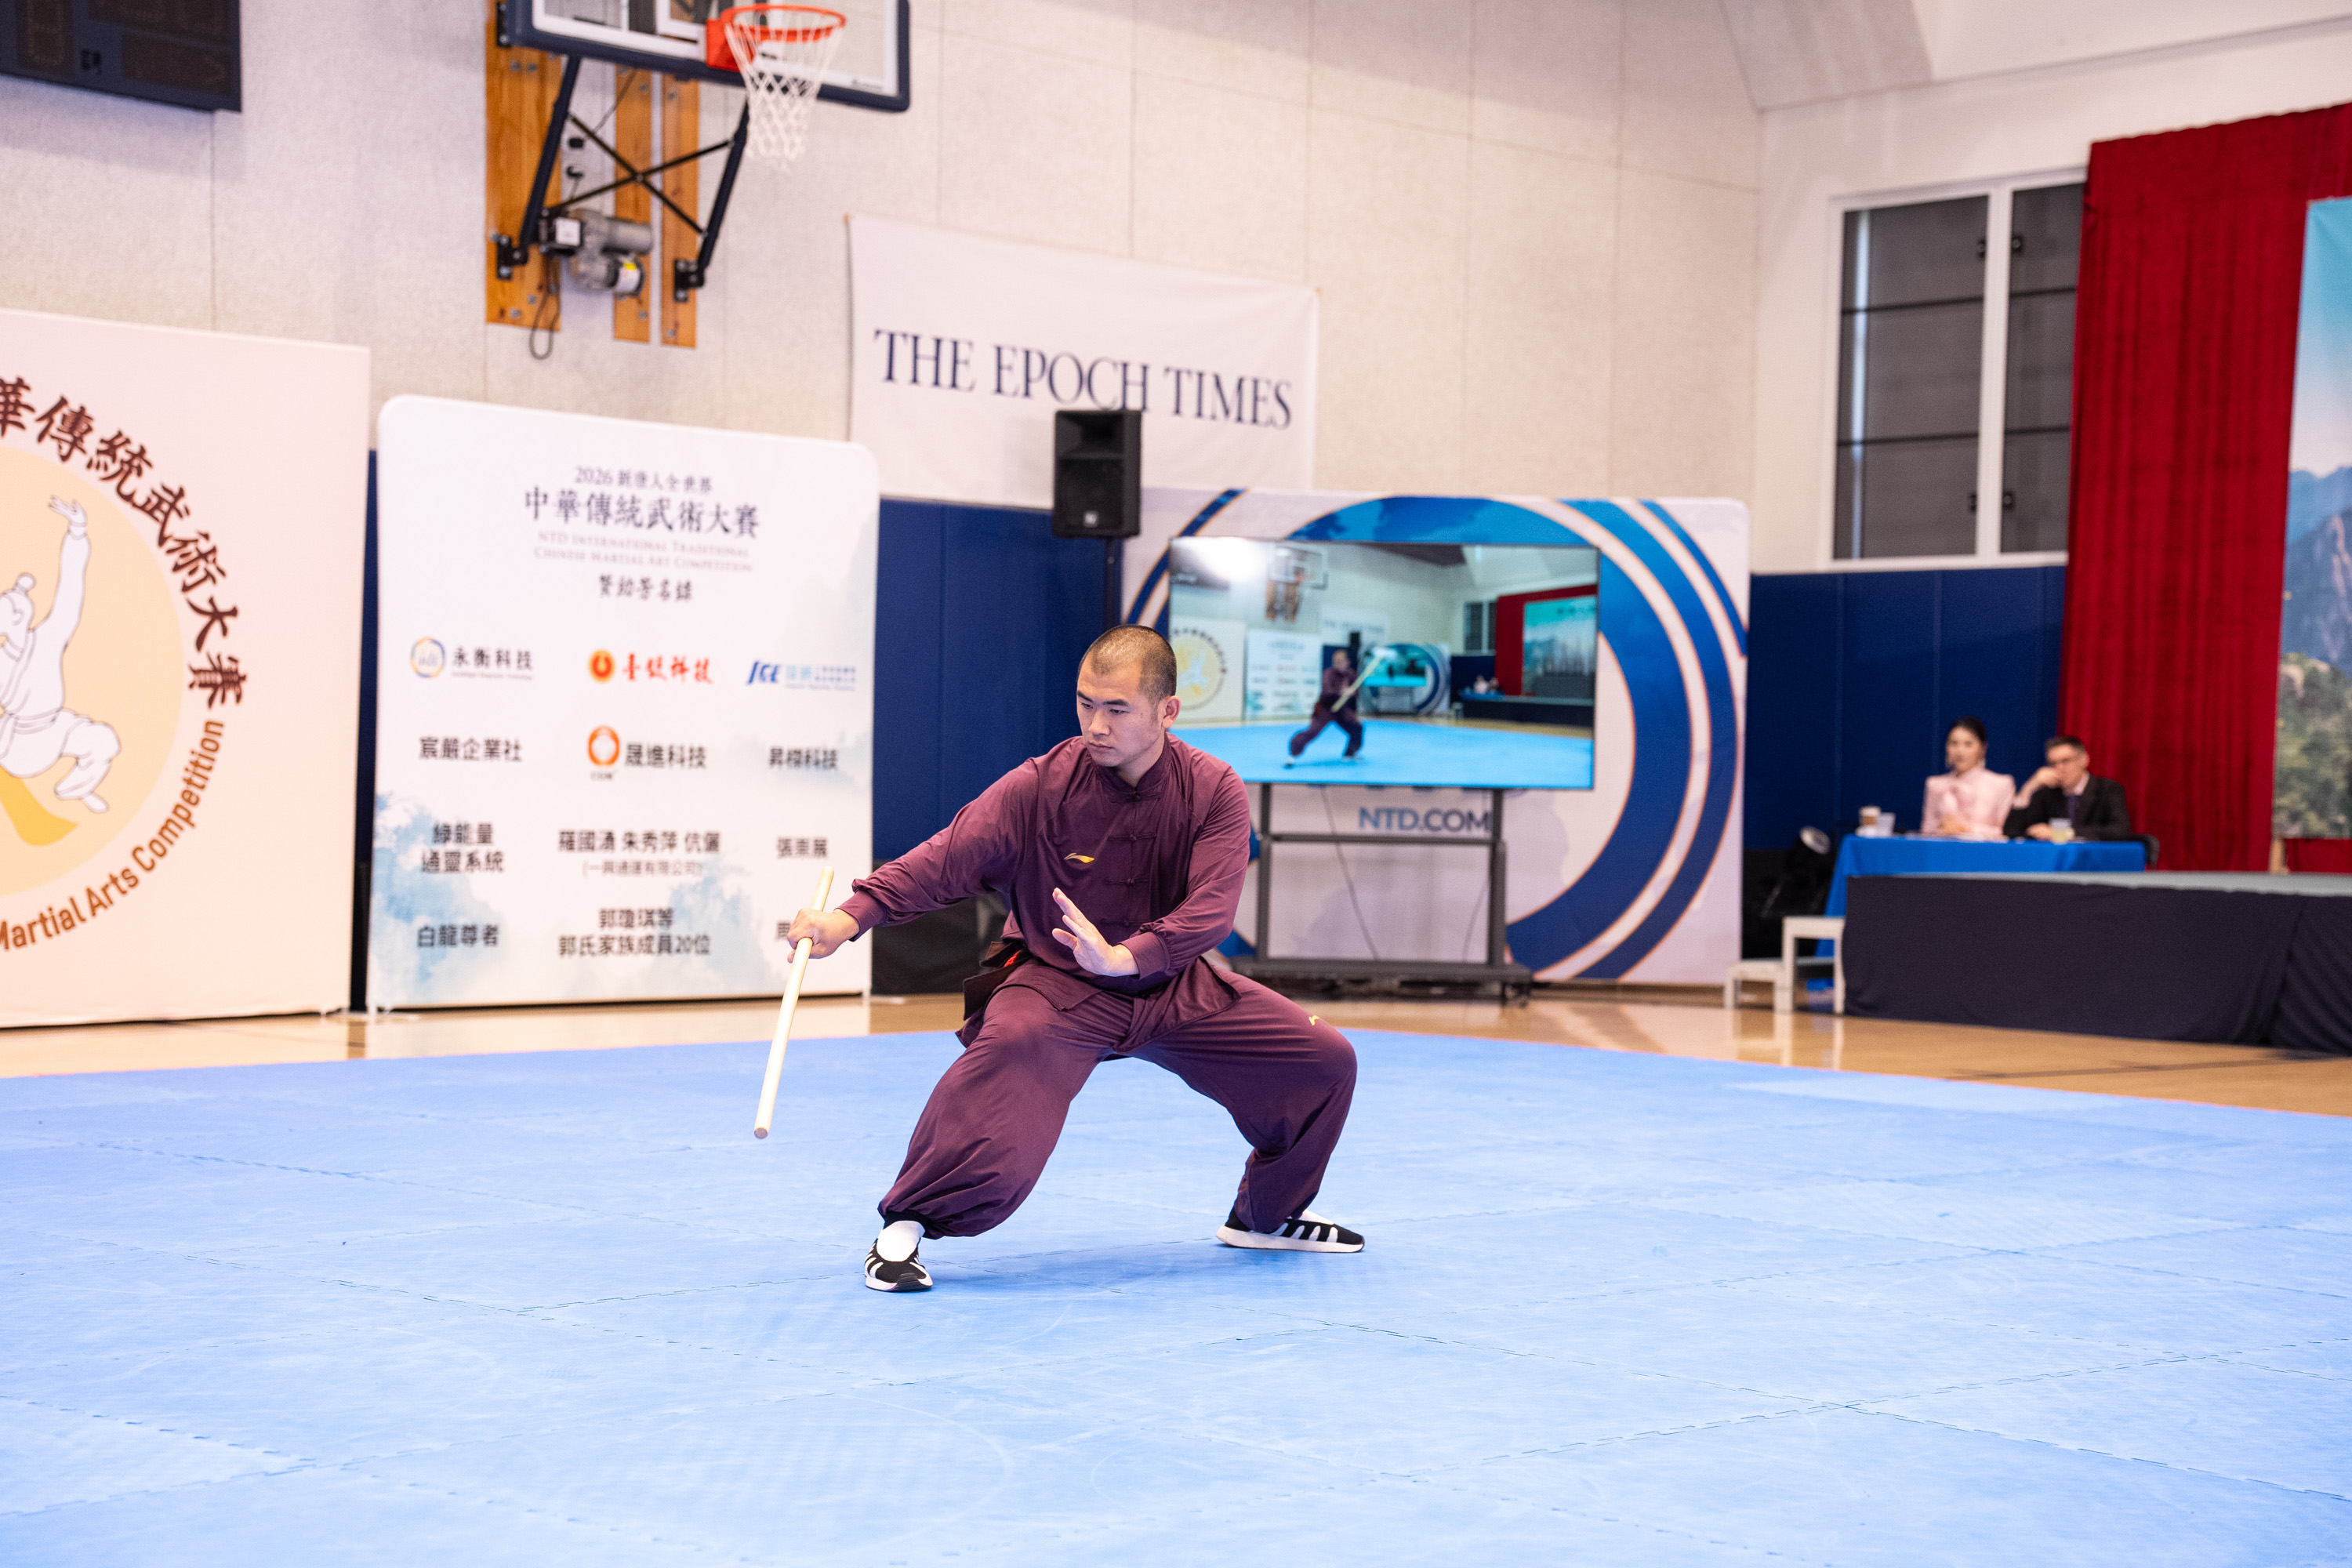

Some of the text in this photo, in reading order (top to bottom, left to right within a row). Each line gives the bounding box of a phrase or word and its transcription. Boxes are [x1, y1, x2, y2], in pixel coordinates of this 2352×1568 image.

[873, 328, 1293, 430] THE EPOCH TIMES
[524, 484, 760, 539] 中華傳統武術大賽
[85, 866, 140, 918] Arts
[130, 718, 224, 873] Competition
[1359, 807, 1493, 833] NTD.COM
